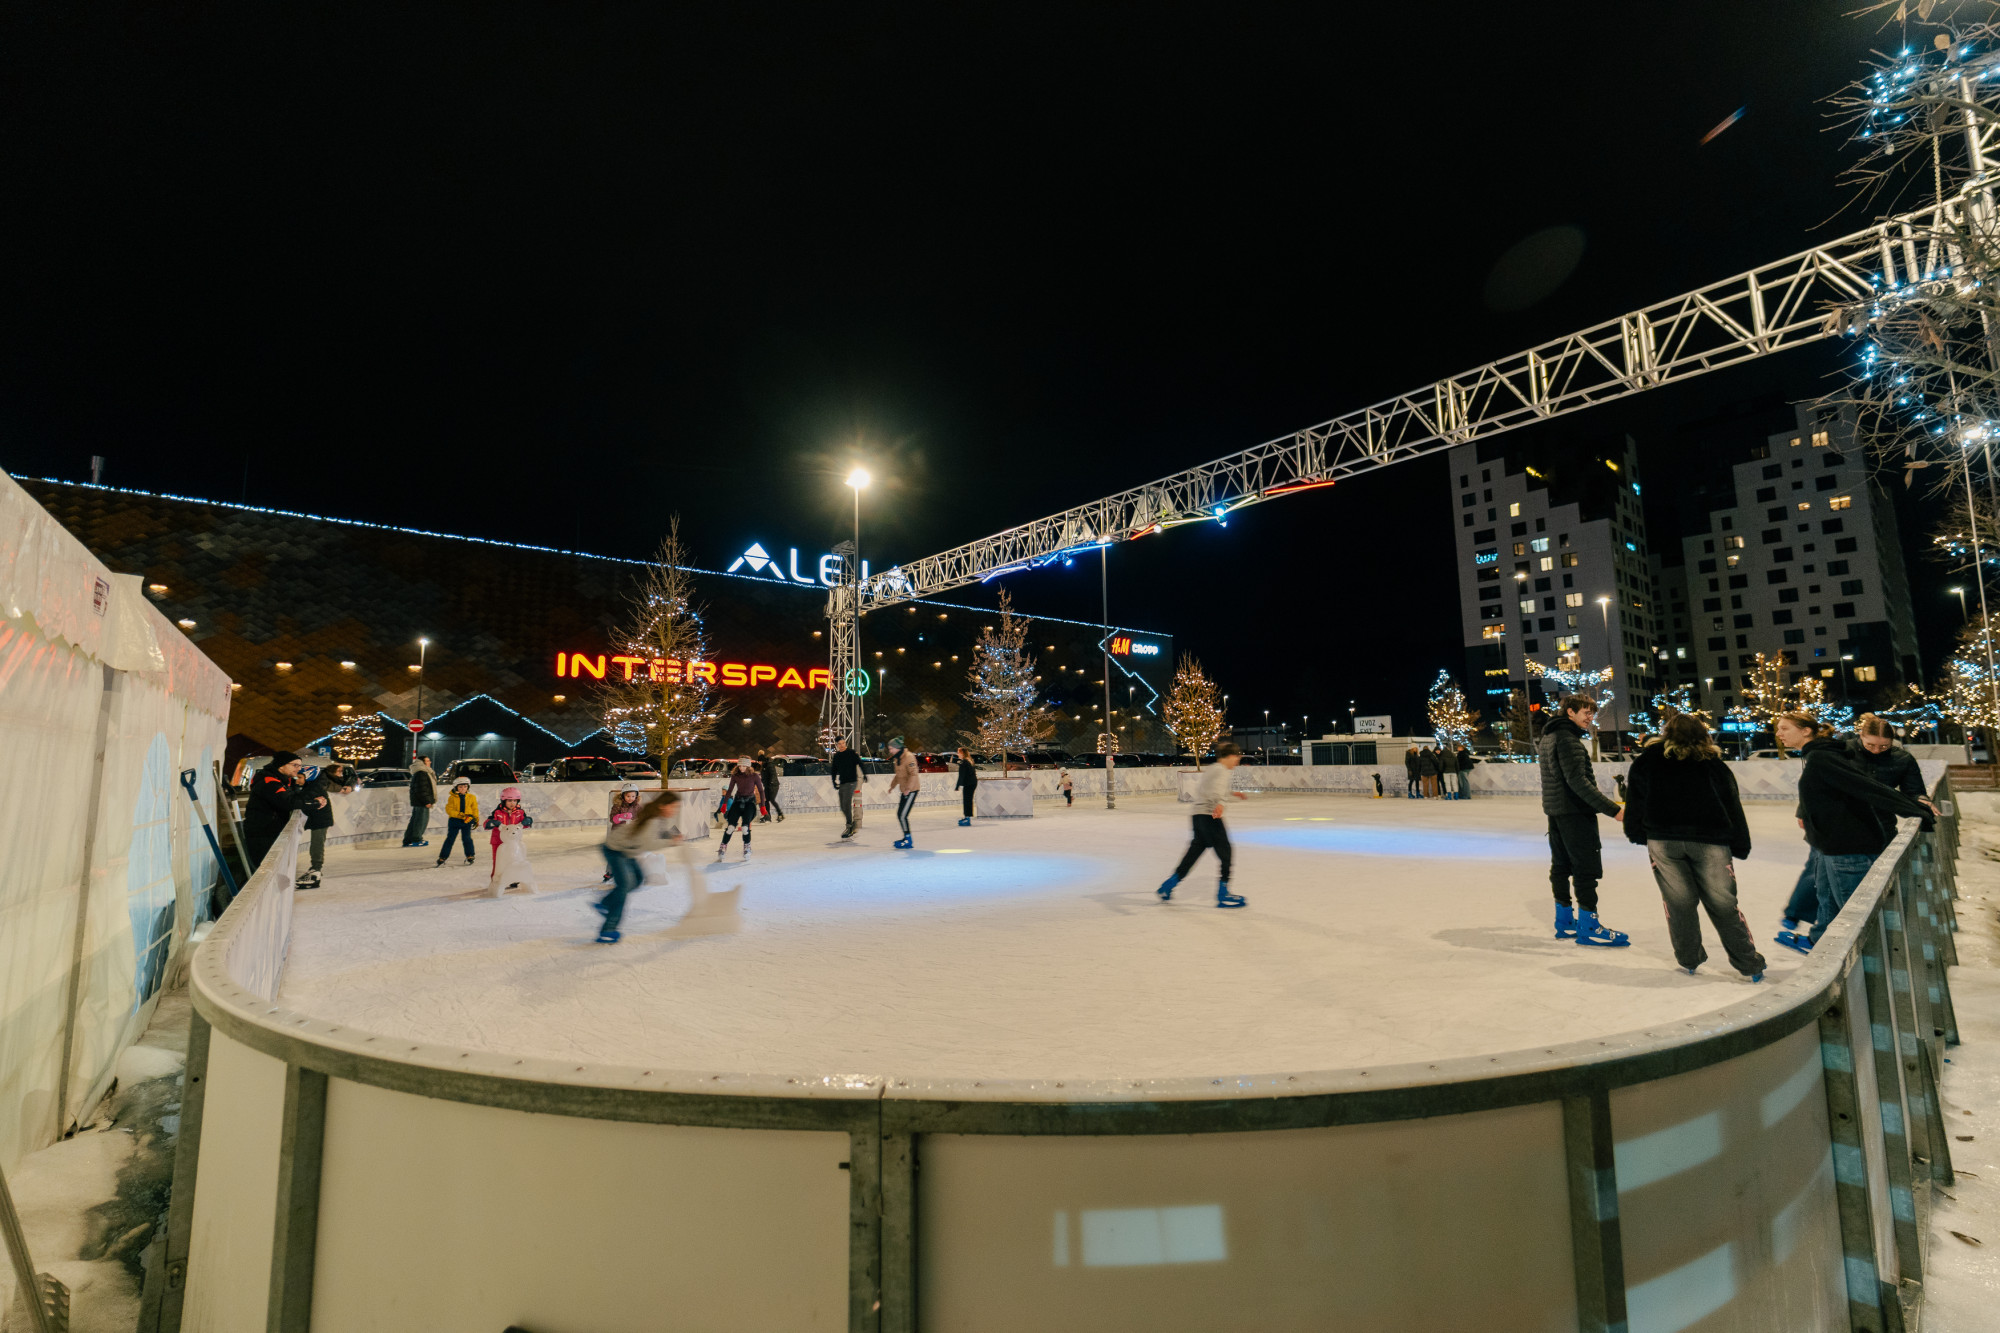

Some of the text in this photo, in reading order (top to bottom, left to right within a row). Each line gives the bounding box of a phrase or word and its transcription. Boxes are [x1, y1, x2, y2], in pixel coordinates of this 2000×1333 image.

[1111, 637, 1131, 655] H&M
[1132, 643, 1158, 655] CROPP
[556, 652, 834, 690] INTERSPAR
